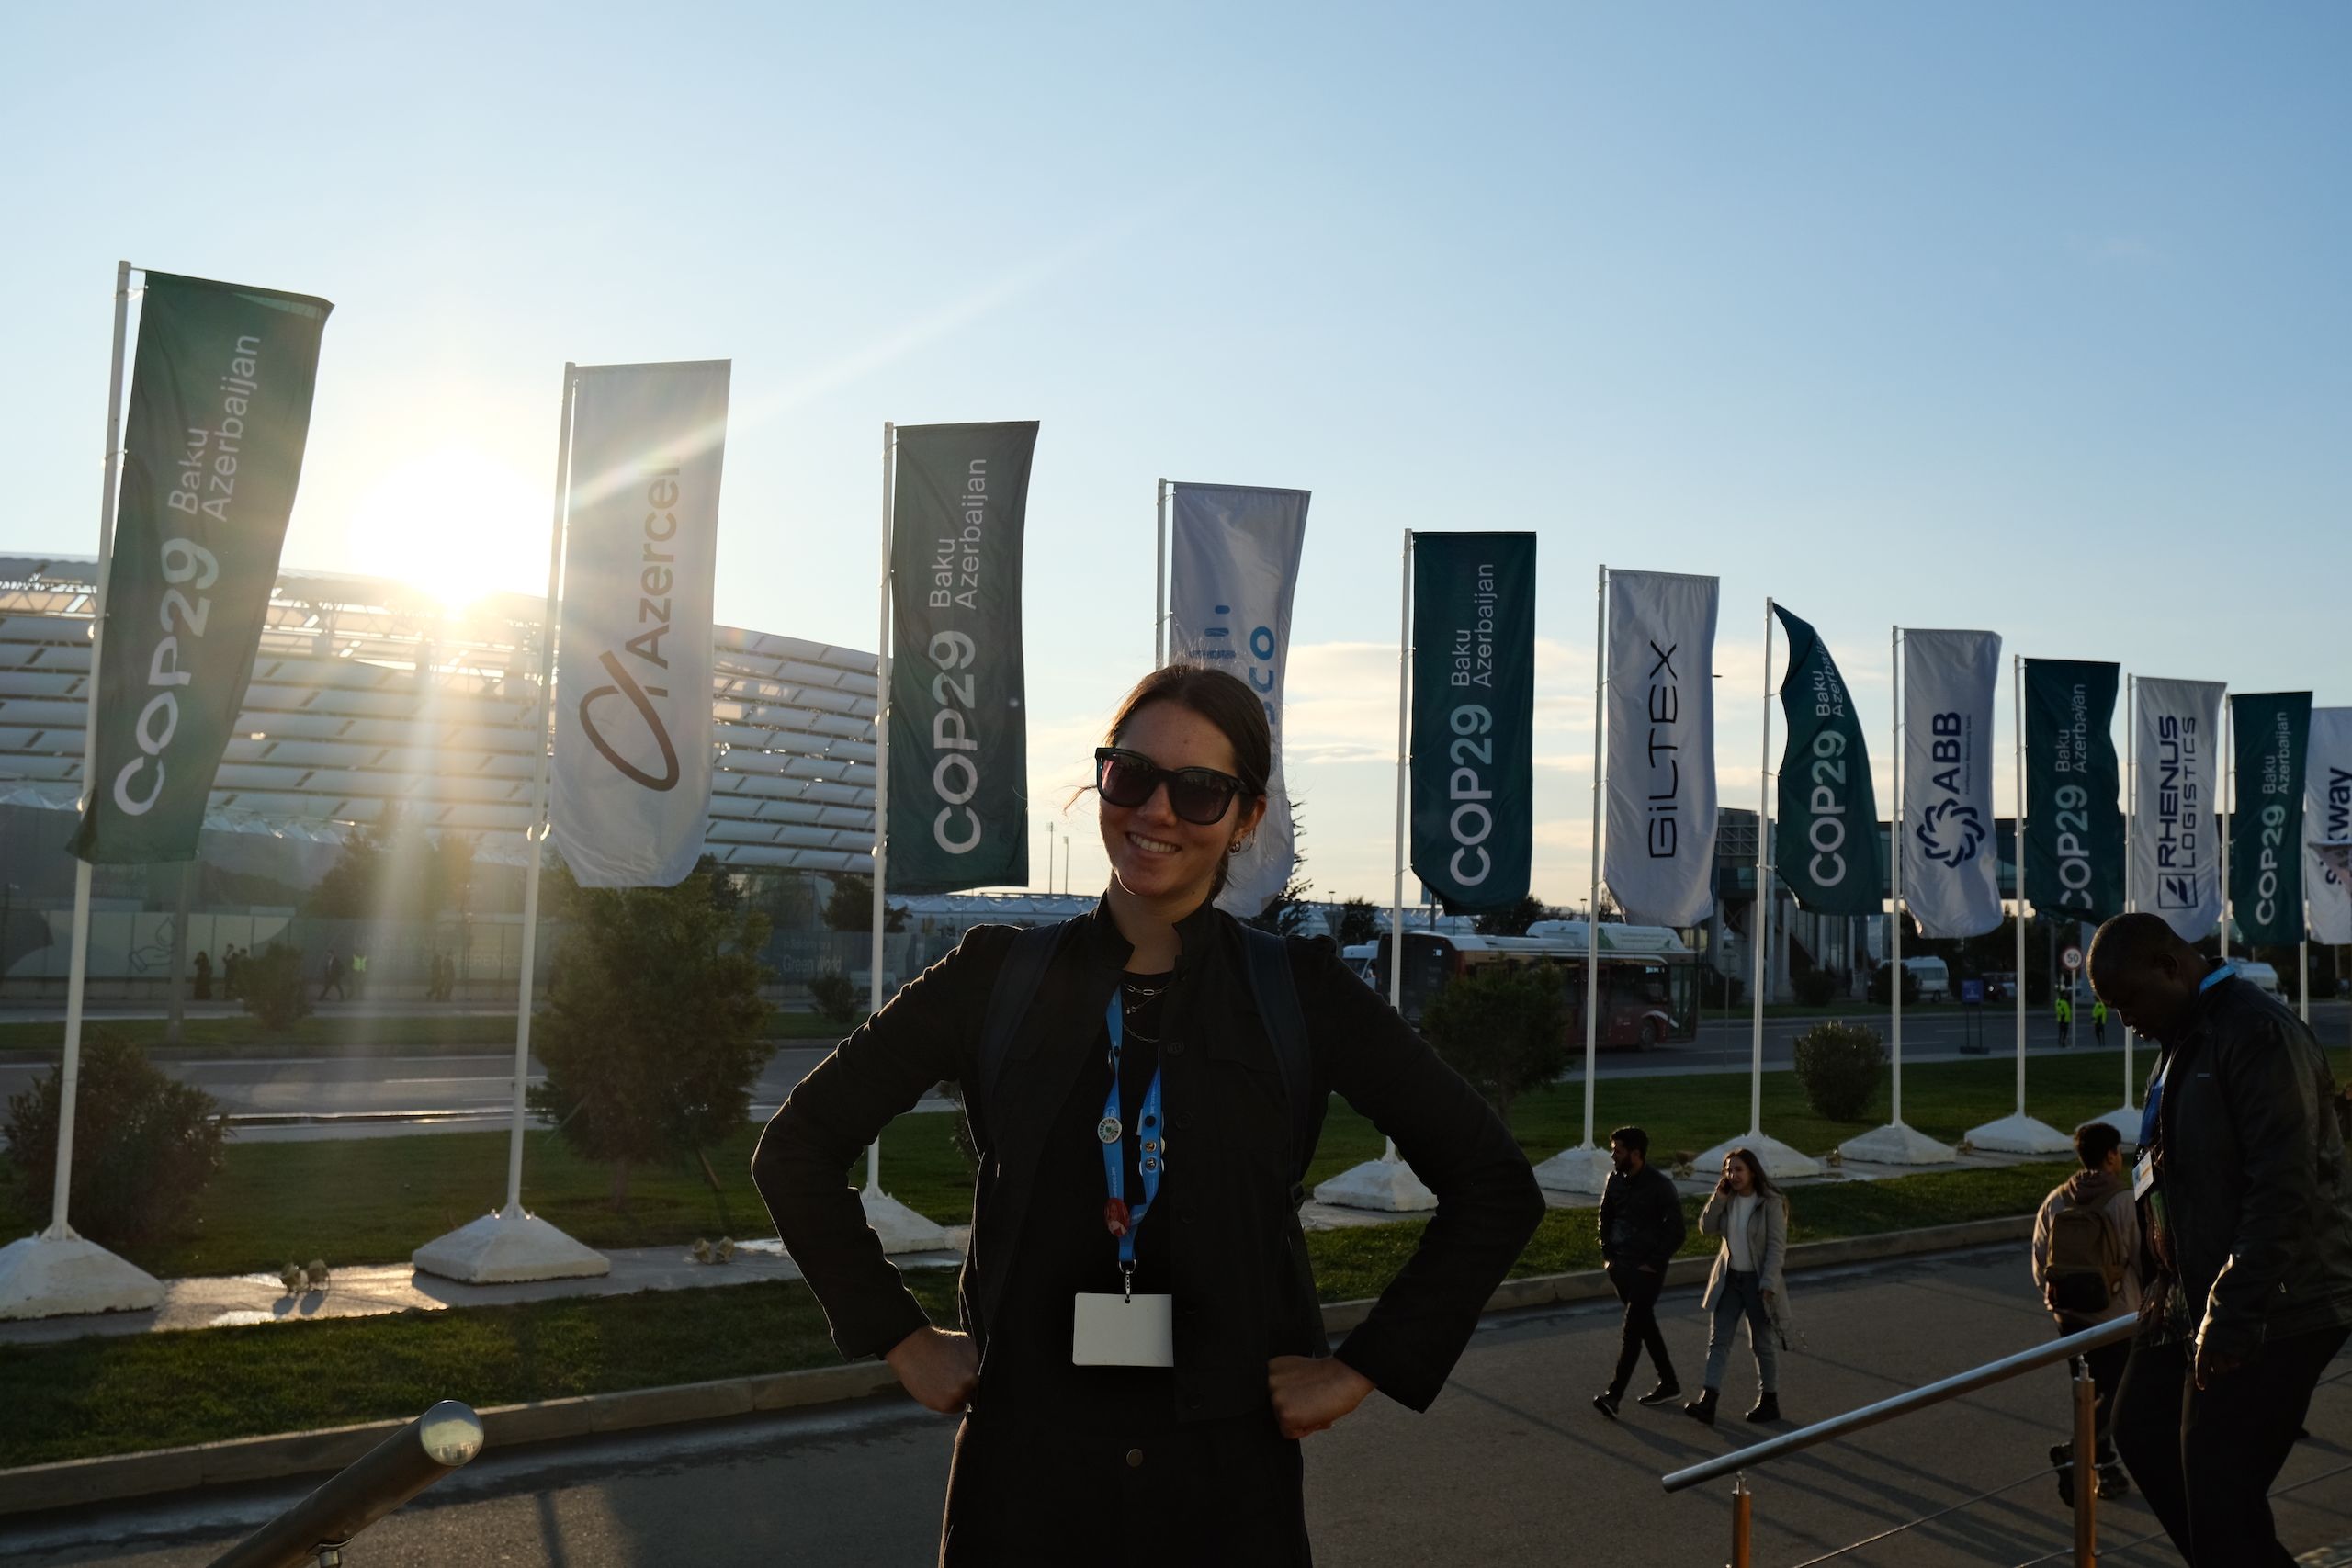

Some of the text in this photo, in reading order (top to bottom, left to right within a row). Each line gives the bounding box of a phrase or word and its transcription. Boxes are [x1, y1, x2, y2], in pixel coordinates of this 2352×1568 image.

[168, 427, 209, 515] Baku
[201, 335, 260, 522] Azerbaijan
[625, 466, 680, 670] Azercel
[929, 538, 956, 608] Baku
[954, 458, 988, 610] Azerbaijan
[113, 537, 220, 816] COP29
[1451, 629, 1471, 686] Baku
[1472, 564, 1498, 688] Azerbaijan
[928, 630, 981, 855] COP29
[1812, 670, 1831, 716] Baku
[1932, 712, 1962, 795] ABB
[2054, 728, 2071, 772] Baku
[2072, 683, 2087, 773] Azerbaijan
[2275, 712, 2291, 795] Azerbaijan
[1449, 704, 1493, 886] COP29
[1809, 730, 1847, 887] COP29
[2158, 716, 2179, 868] RHENUS
[2182, 716, 2197, 869] LOGISTICS
[2262, 755, 2277, 794] Baku
[2055, 784, 2093, 909] COP29
[2256, 804, 2286, 925] COP29
[2067, 954, 2079, 964] 50
